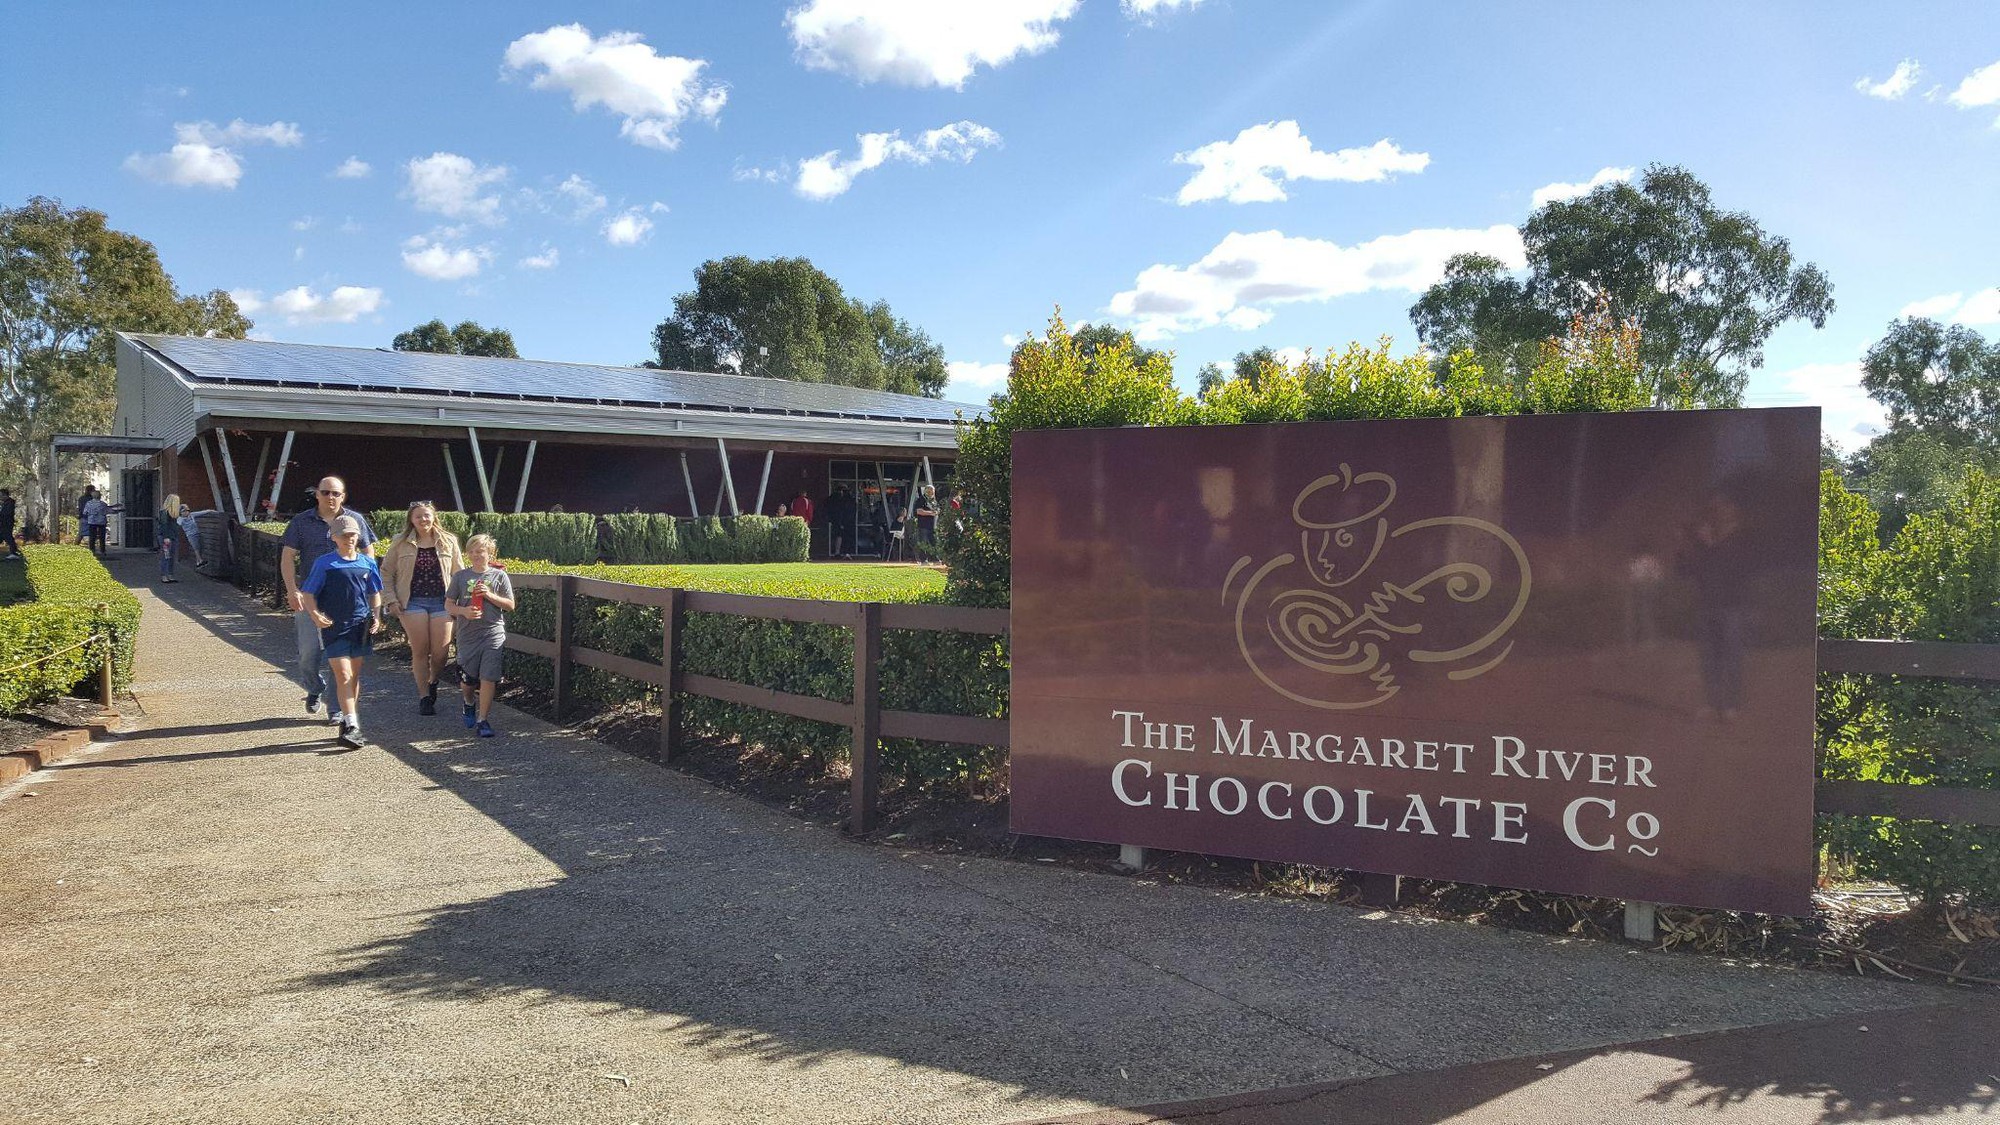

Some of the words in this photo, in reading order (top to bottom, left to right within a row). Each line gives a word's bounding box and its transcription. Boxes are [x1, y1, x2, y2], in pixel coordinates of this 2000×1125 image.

[1111, 709, 1196, 752] THE
[1211, 716, 1475, 773] MARGARET
[1490, 735, 1658, 788] RIVER
[1111, 758, 1528, 845] CHOCOLATE
